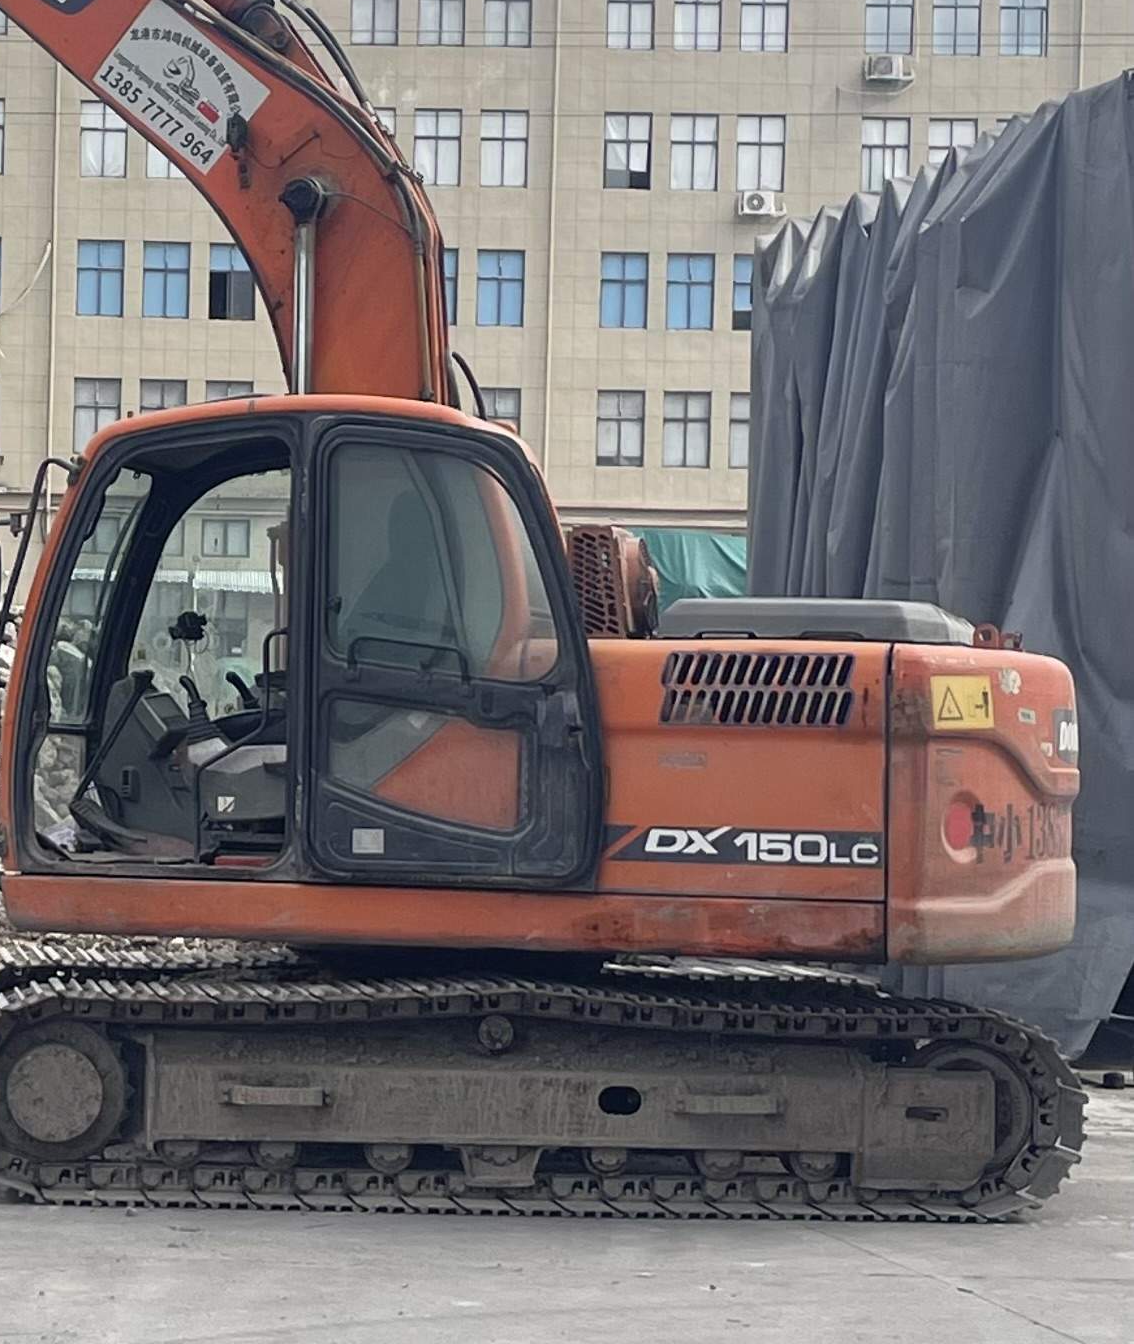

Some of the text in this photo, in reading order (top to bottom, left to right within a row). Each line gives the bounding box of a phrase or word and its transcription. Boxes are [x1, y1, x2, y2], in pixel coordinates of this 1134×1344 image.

[100, 65, 214, 164] 1385 7777 964
